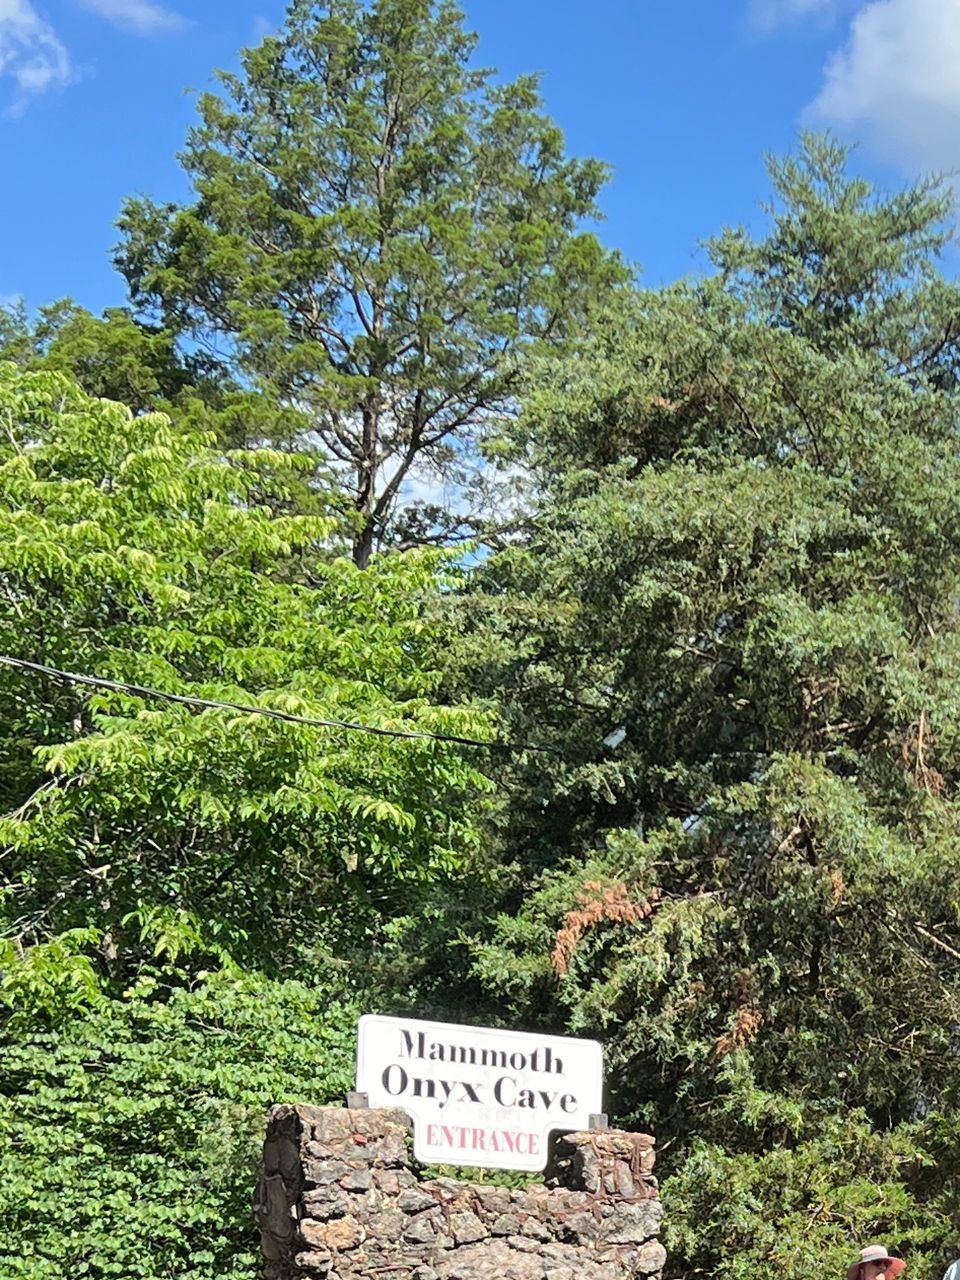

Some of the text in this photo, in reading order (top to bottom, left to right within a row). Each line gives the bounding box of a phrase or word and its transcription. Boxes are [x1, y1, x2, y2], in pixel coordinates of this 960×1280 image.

[398, 1029, 565, 1075] Mammoth
[382, 1064, 578, 1114] Onyx Cave
[426, 1124, 540, 1155] ENTRANCE
